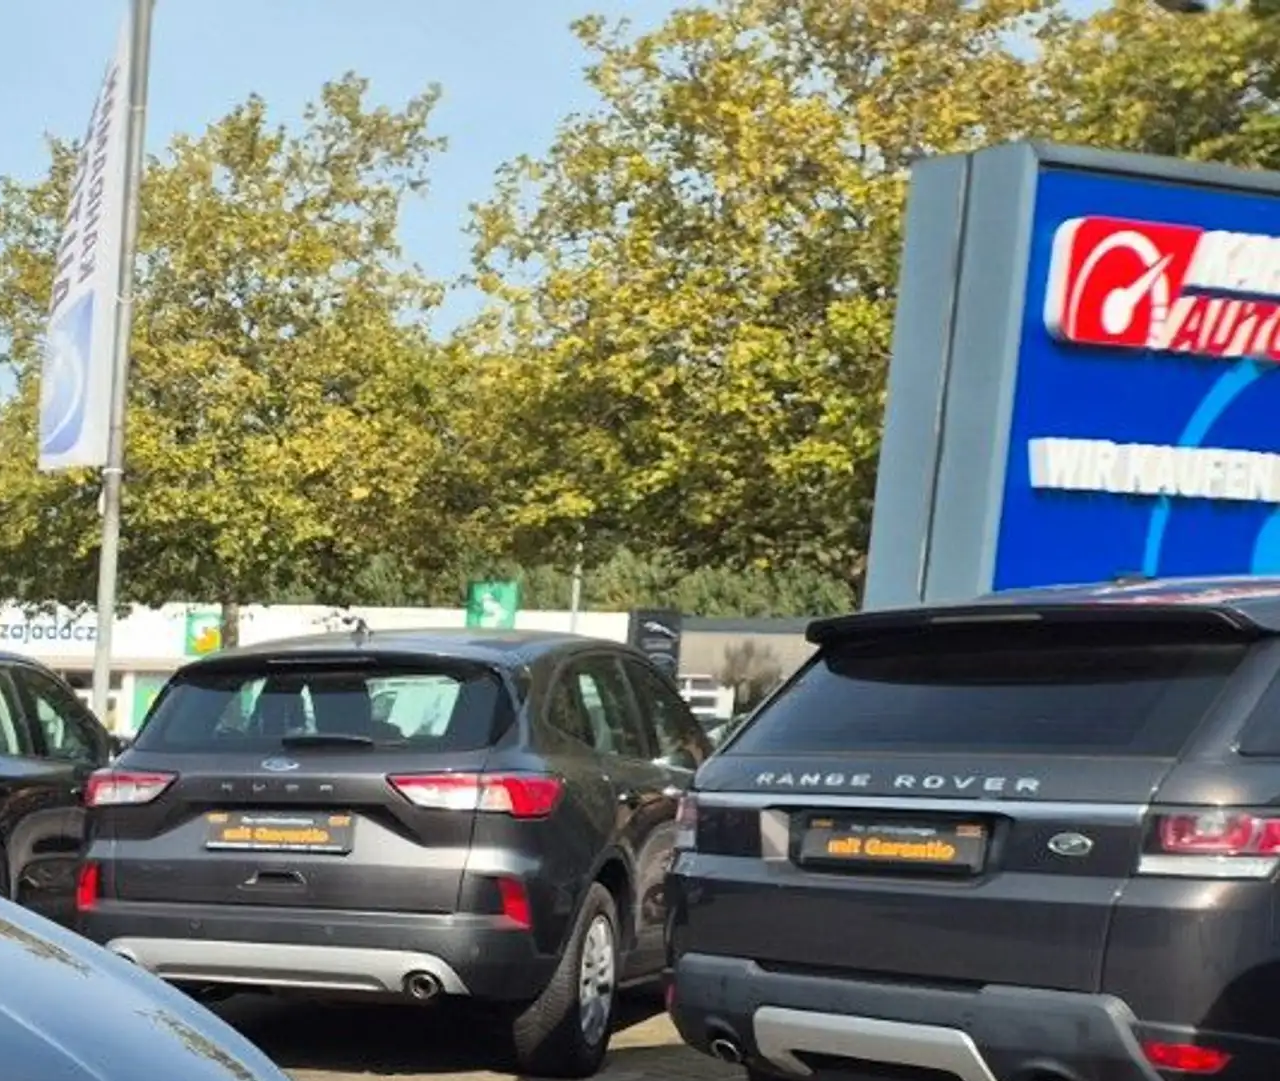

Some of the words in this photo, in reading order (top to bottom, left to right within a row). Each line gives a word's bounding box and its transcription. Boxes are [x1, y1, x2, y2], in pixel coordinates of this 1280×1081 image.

[1030, 436, 1117, 492] WIR
[1118, 442, 1280, 503] KAUFEN
[755, 772, 871, 788] RANGE
[894, 775, 1040, 792] ROVER
[828, 837, 861, 854] mit
[864, 837, 956, 861] Garantie
